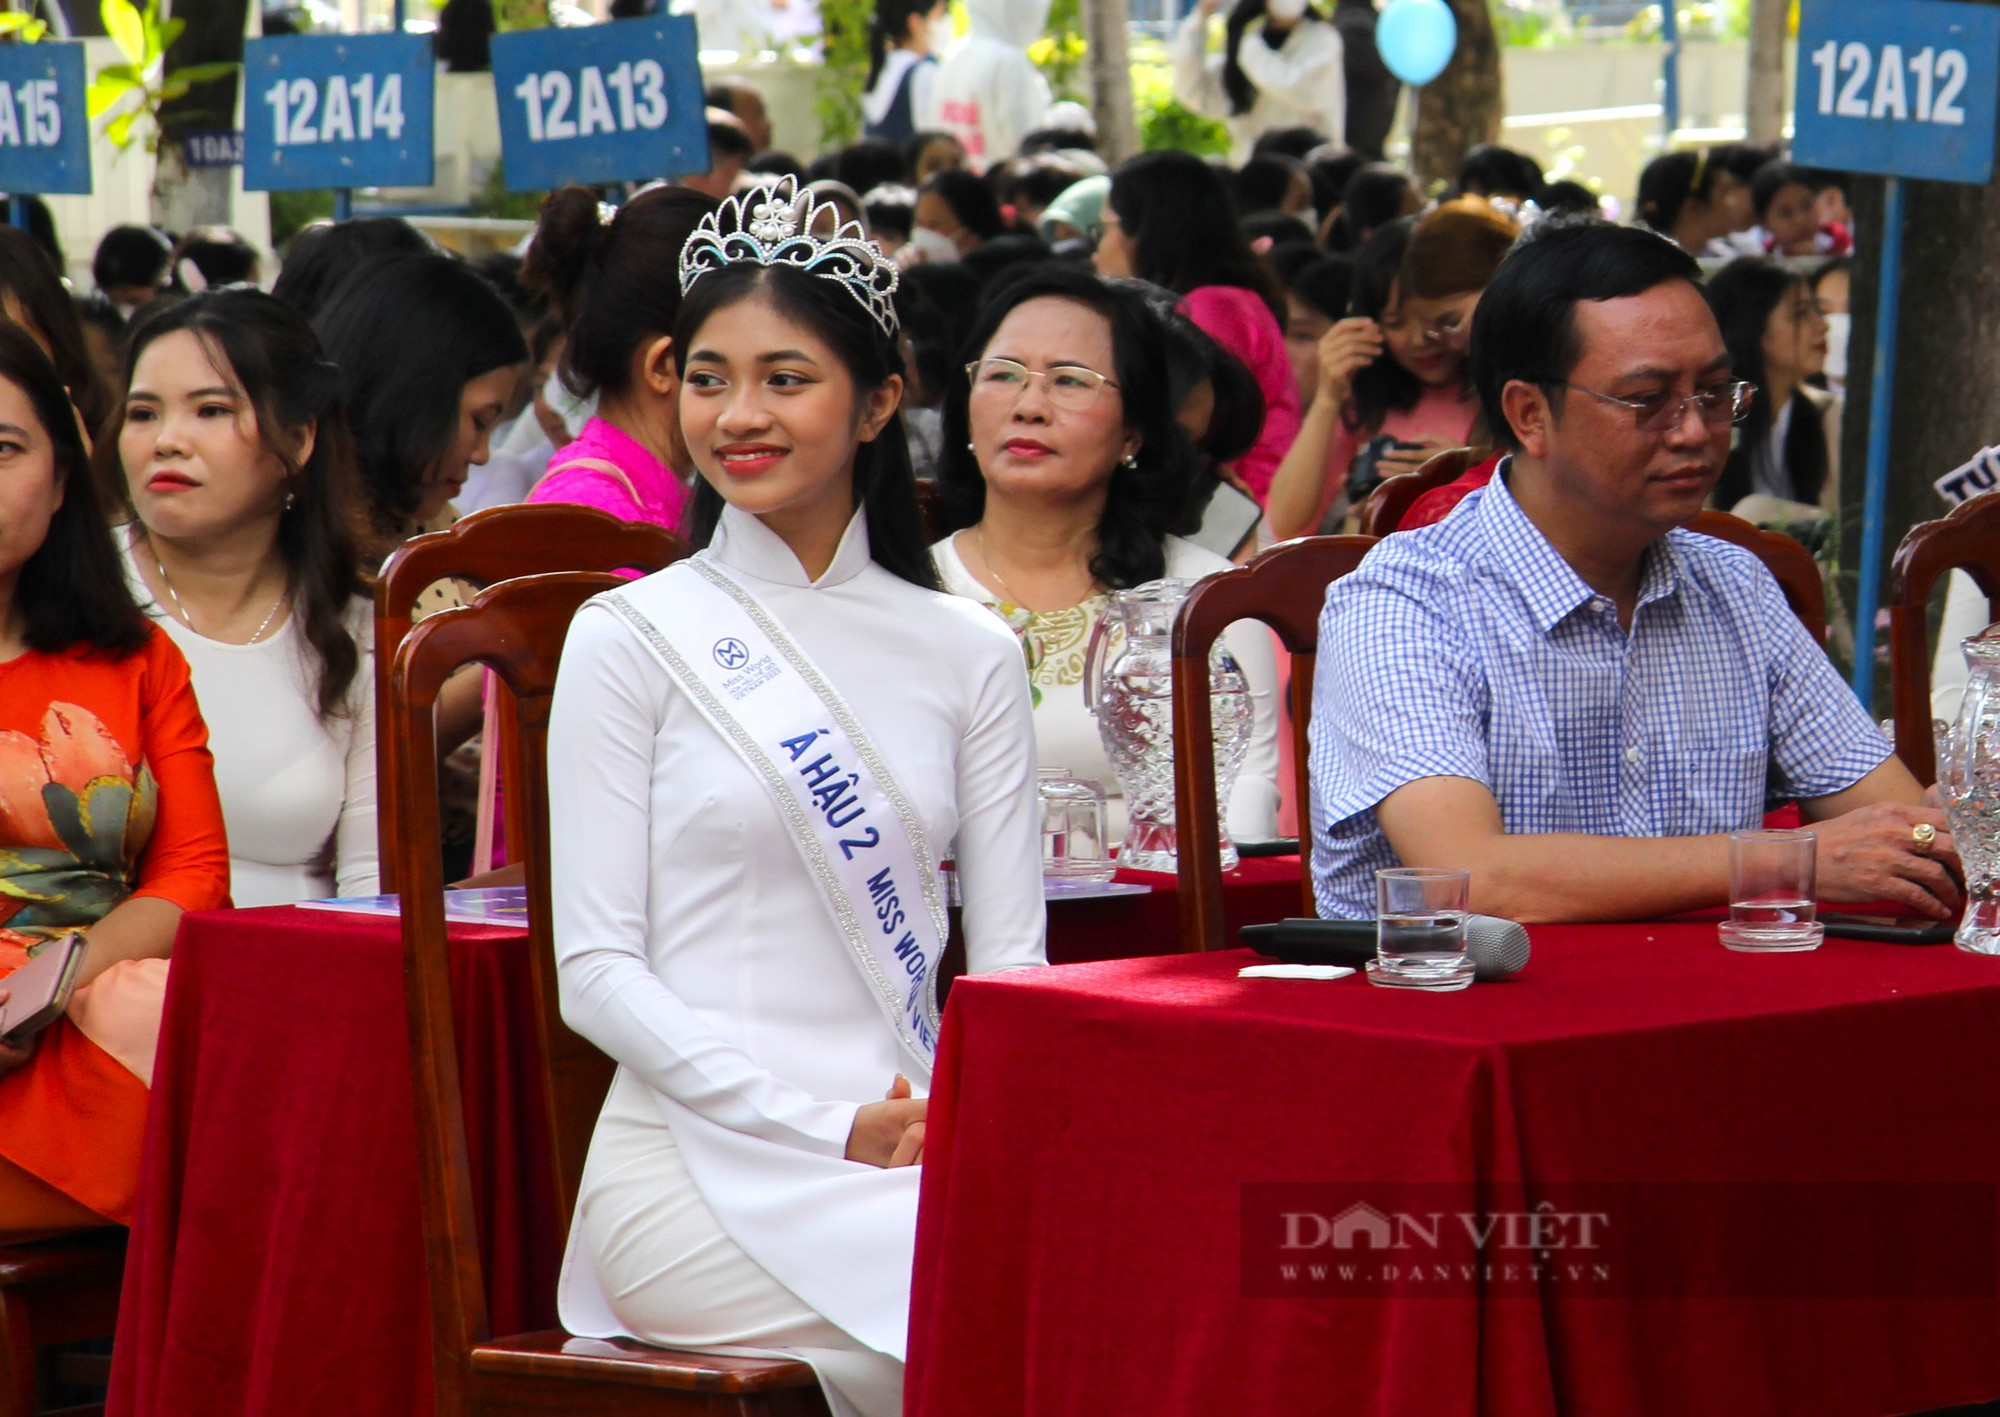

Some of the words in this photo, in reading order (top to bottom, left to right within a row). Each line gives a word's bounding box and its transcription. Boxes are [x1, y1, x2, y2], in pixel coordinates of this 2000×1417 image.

[265, 73, 405, 145] 12A14
[514, 58, 668, 142] 12A13
[1812, 39, 1969, 125] 12A12
[722, 673, 745, 690] Miss
[742, 654, 772, 675] World
[779, 728, 830, 762] Á
[800, 753, 866, 829] HẬU
[838, 826, 880, 861] 2
[866, 866, 905, 935] MISS
